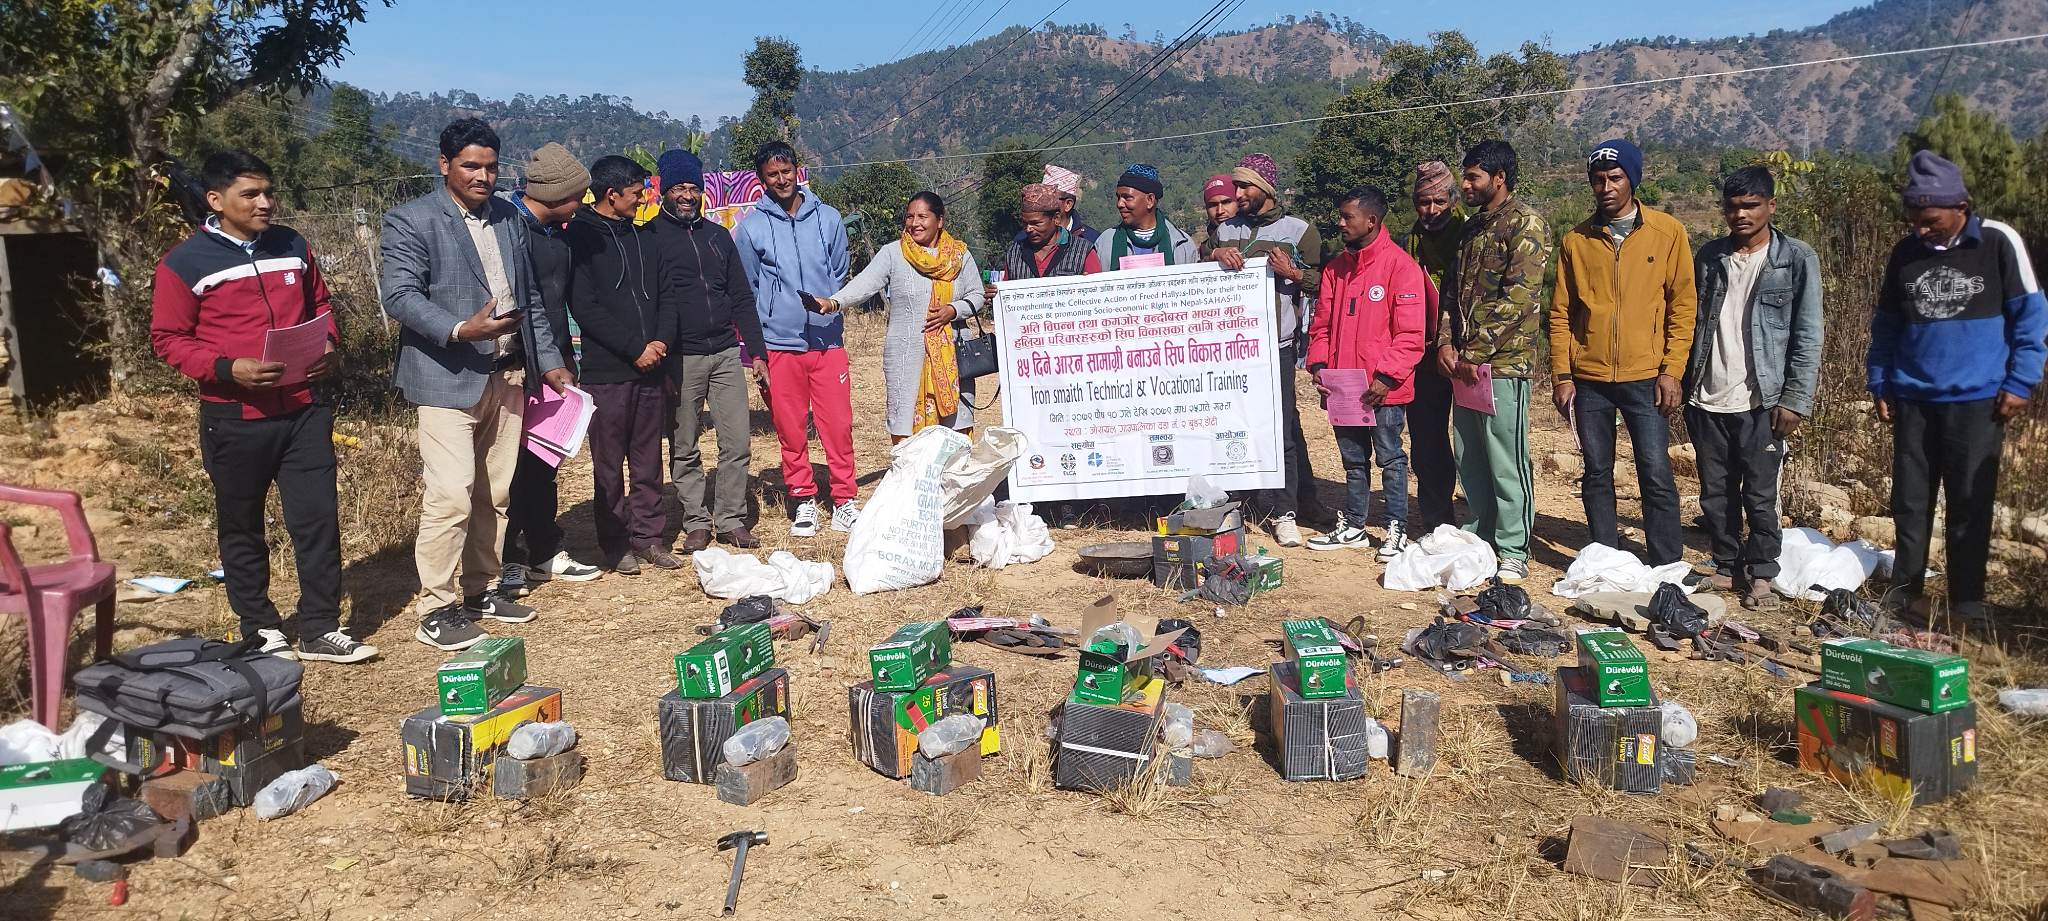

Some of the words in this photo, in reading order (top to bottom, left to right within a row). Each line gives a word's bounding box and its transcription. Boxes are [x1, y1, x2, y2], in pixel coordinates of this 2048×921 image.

[1004, 302, 1053, 313] (Strengthening
[1055, 299, 1065, 308] the
[1068, 297, 1101, 307] Collective
[1104, 295, 1127, 304] Action
[1130, 294, 1137, 302] of
[1139, 292, 1159, 301] Freed
[1206, 287, 1216, 295] for
[1219, 285, 1235, 294] their
[1237, 283, 1258, 292] better
[1020, 313, 1044, 321] Access
[1150, 301, 1169, 311] Right
[1014, 335, 1044, 349] हलिया
[1115, 328, 1135, 340] सिप
[1138, 323, 1184, 338] विकासका
[1188, 319, 1213, 334] लागि
[1019, 321, 1040, 333] अति
[1078, 319, 1098, 330] तथा
[1101, 313, 1141, 327] कमजोर
[1192, 308, 1220, 319] भएका
[1016, 357, 1030, 378] ४५
[1031, 350, 1052, 376] दिने
[1054, 353, 1083, 375] आरन
[1086, 345, 1124, 373] सामाग्री
[1126, 341, 1161, 369] बनाउने
[1164, 339, 1184, 367] सिप
[1187, 337, 1221, 364] विकास
[1225, 332, 1260, 361] तालिम
[1030, 385, 1052, 406] Iron
[1086, 378, 1133, 402] Technical
[1136, 380, 1146, 396] &
[1150, 374, 1203, 398] Vocational
[1207, 371, 1248, 394] Training
[878, 550, 916, 569] BORAX
[922, 695, 931, 708] 25
